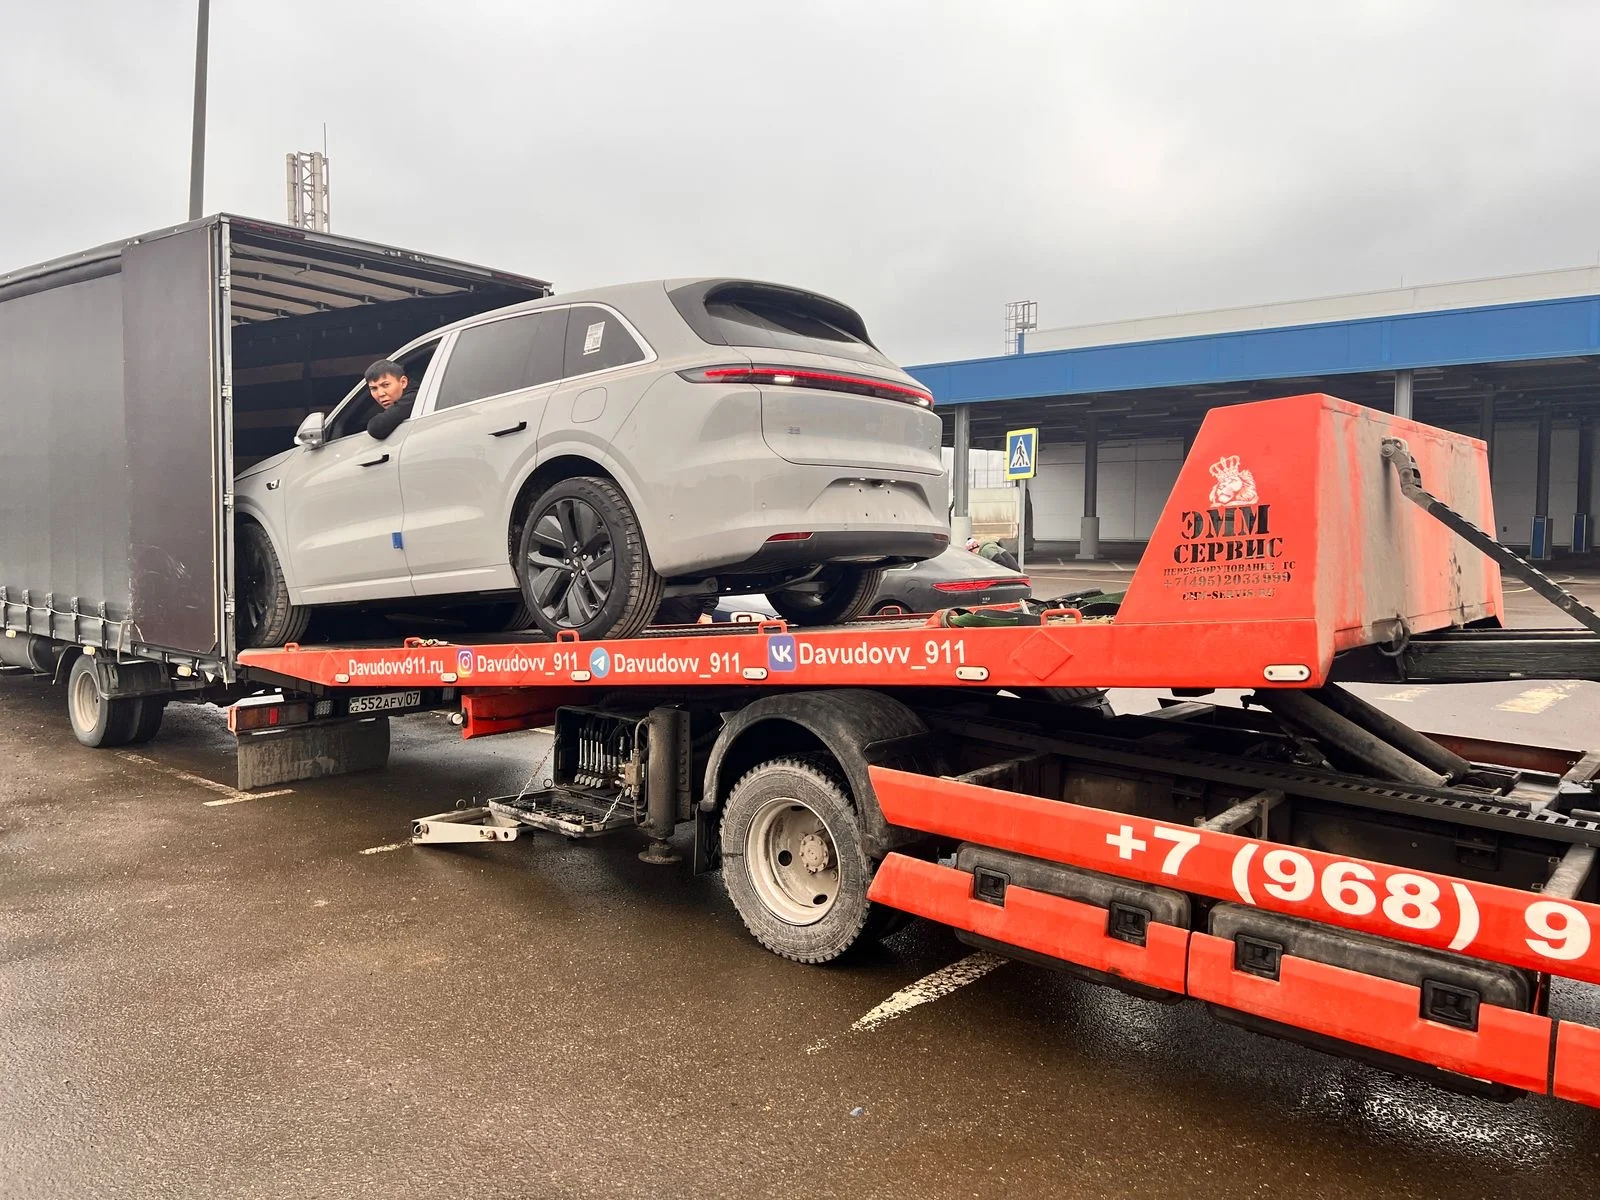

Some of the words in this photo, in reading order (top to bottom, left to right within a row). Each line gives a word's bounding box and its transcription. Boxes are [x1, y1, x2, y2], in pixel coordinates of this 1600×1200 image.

[1181, 504, 1271, 540] ЭММ
[1173, 537, 1283, 564] СЕРВИС
[348, 656, 444, 677] Davudovv911.ru
[477, 652, 578, 676] Davudovv_911
[614, 652, 741, 679] Davudovv_911
[799, 640, 965, 671] Davudovv_911
[1105, 824, 1201, 876] +7
[1231, 843, 1481, 950] (968)
